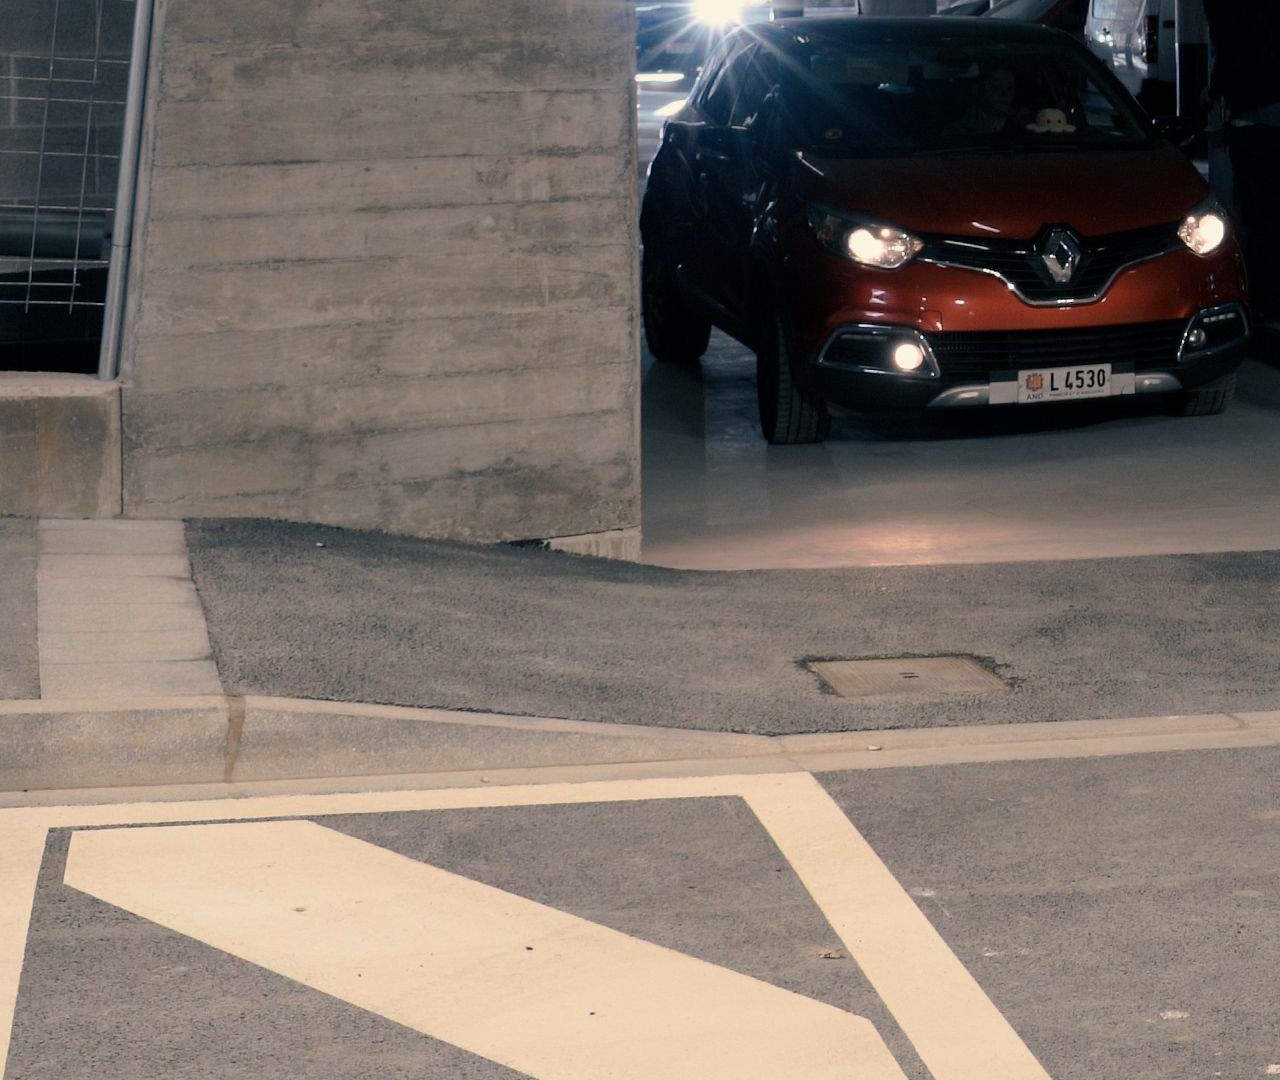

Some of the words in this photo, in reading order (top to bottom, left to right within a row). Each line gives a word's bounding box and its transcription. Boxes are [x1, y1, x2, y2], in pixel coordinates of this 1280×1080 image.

[1051, 372, 1059, 391] L
[1065, 369, 1106, 390] 4530
[1026, 393, 1043, 401] AND
